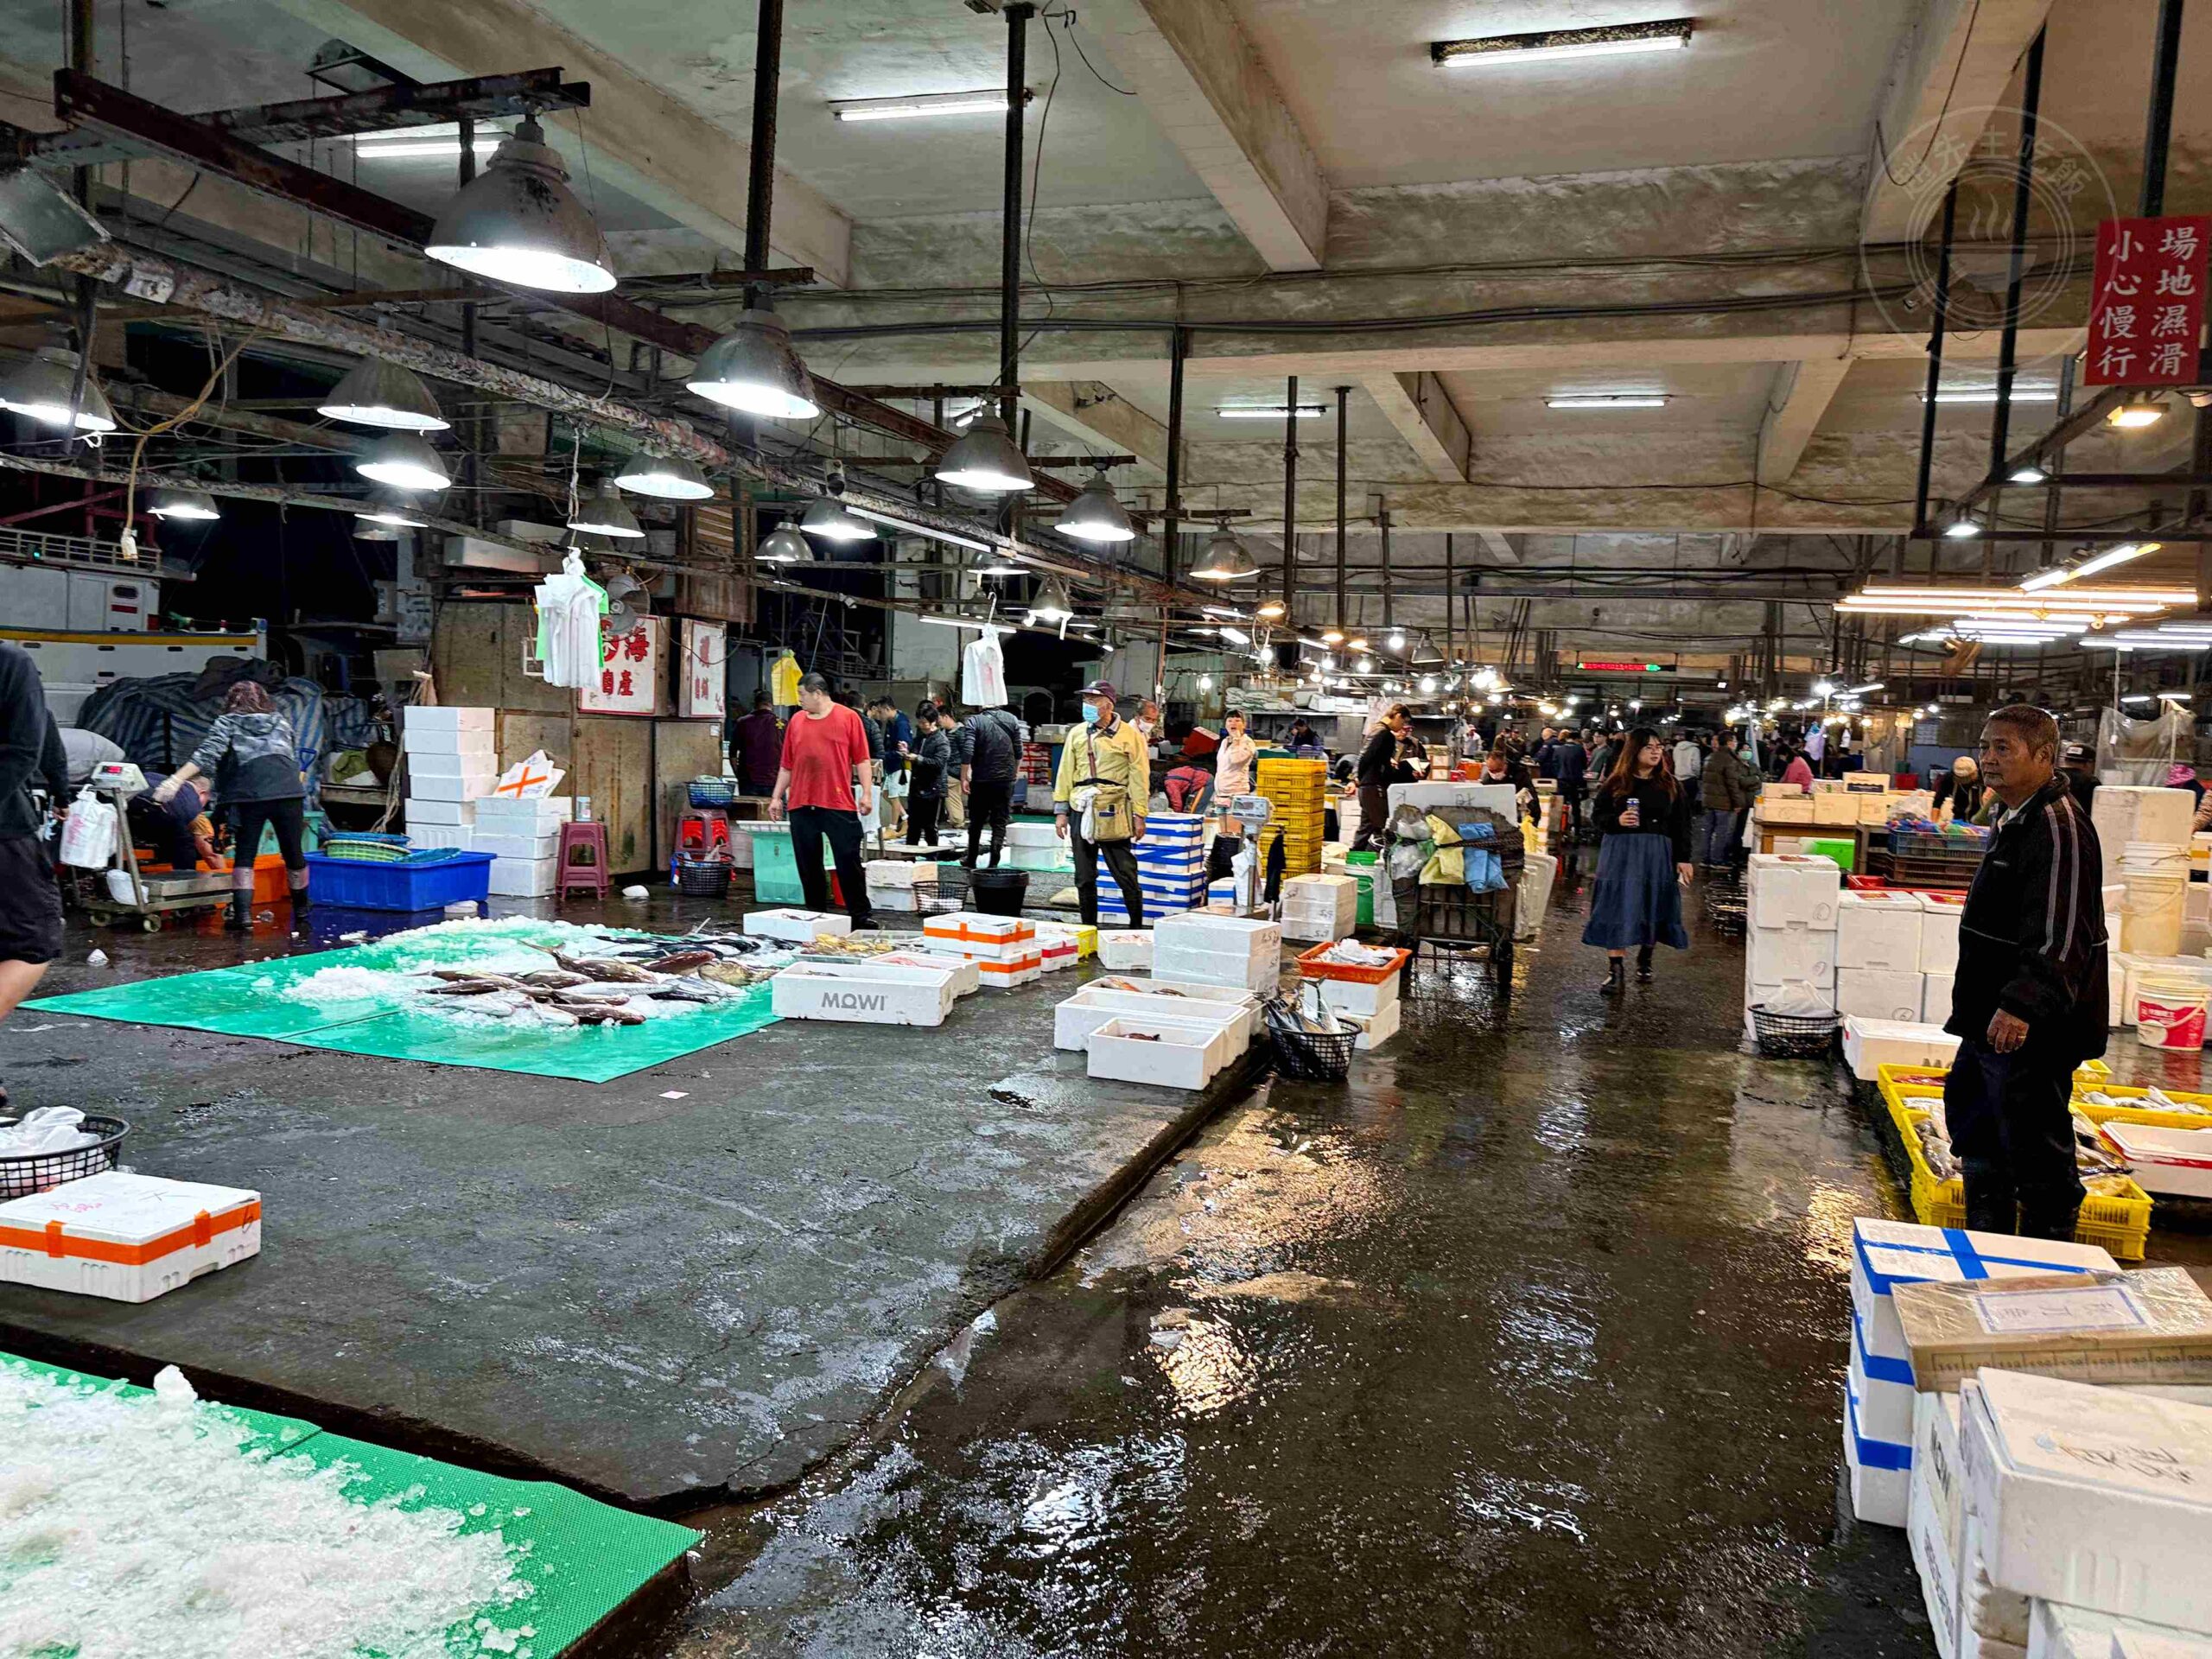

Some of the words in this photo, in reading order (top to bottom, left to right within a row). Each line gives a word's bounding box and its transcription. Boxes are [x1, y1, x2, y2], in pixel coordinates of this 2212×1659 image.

[2097, 231, 2145, 378] 小心慢行
[2148, 226, 2199, 376] 場地濕滑
[822, 992, 885, 1011] MOWI
